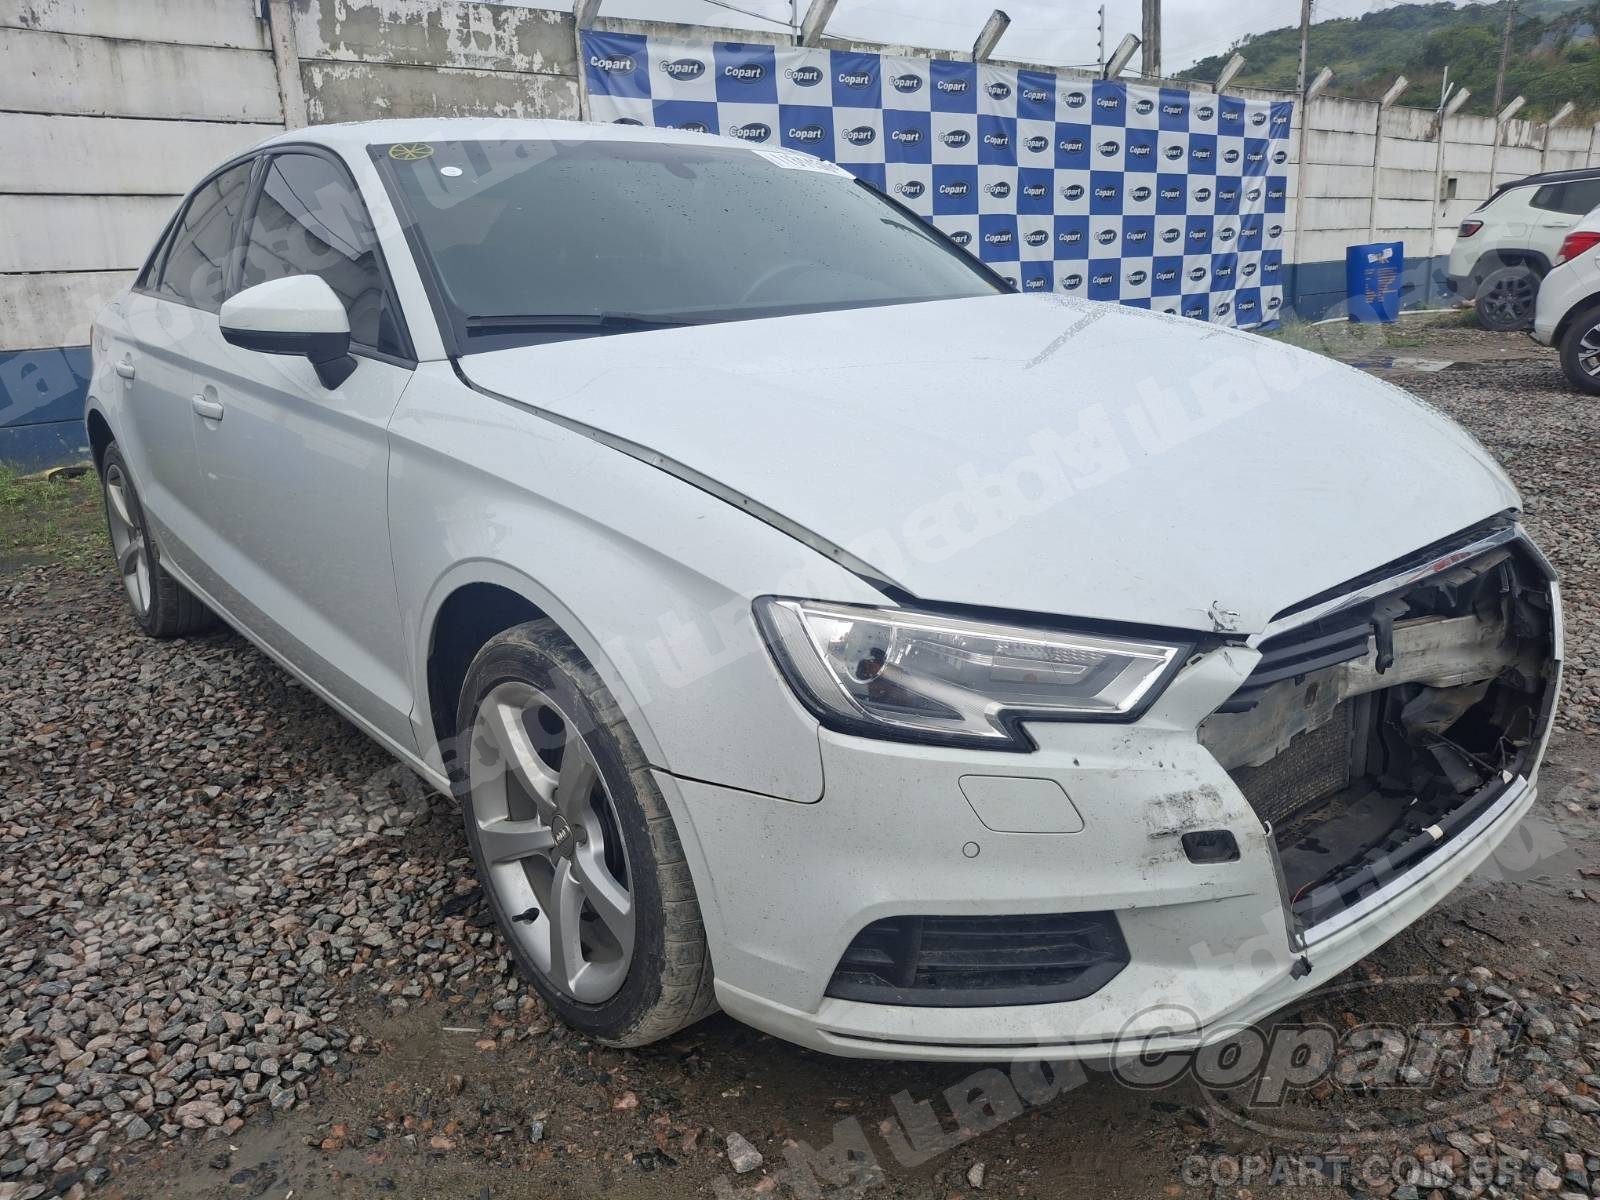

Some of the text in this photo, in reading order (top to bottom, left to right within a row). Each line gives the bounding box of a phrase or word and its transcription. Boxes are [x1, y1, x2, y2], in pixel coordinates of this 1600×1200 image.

[590, 56, 631, 71] Copart
[659, 60, 698, 75] Copart
[724, 66, 761, 80] Copart
[784, 69, 817, 83] Copart
[838, 74, 869, 85] Copart
[889, 76, 917, 88] Copart
[937, 81, 966, 93] Copart
[1023, 90, 1046, 101] Copart
[1133, 101, 1150, 111] opart
[729, 126, 765, 139] Copart
[789, 129, 821, 140] Copart
[842, 129, 871, 141] Copart
[892, 131, 919, 142] Copart
[938, 131, 965, 143] Copart
[984, 135, 1008, 145] Copart
[1162, 148, 1180, 157] opart
[894, 183, 921, 195] Copart
[940, 185, 967, 195] Copart
[984, 184, 1007, 195] Copart
[1062, 187, 1081, 197] opart
[1129, 189, 1148, 197] opart
[985, 234, 1011, 243] Copart
[1060, 277, 1079, 286] opart
